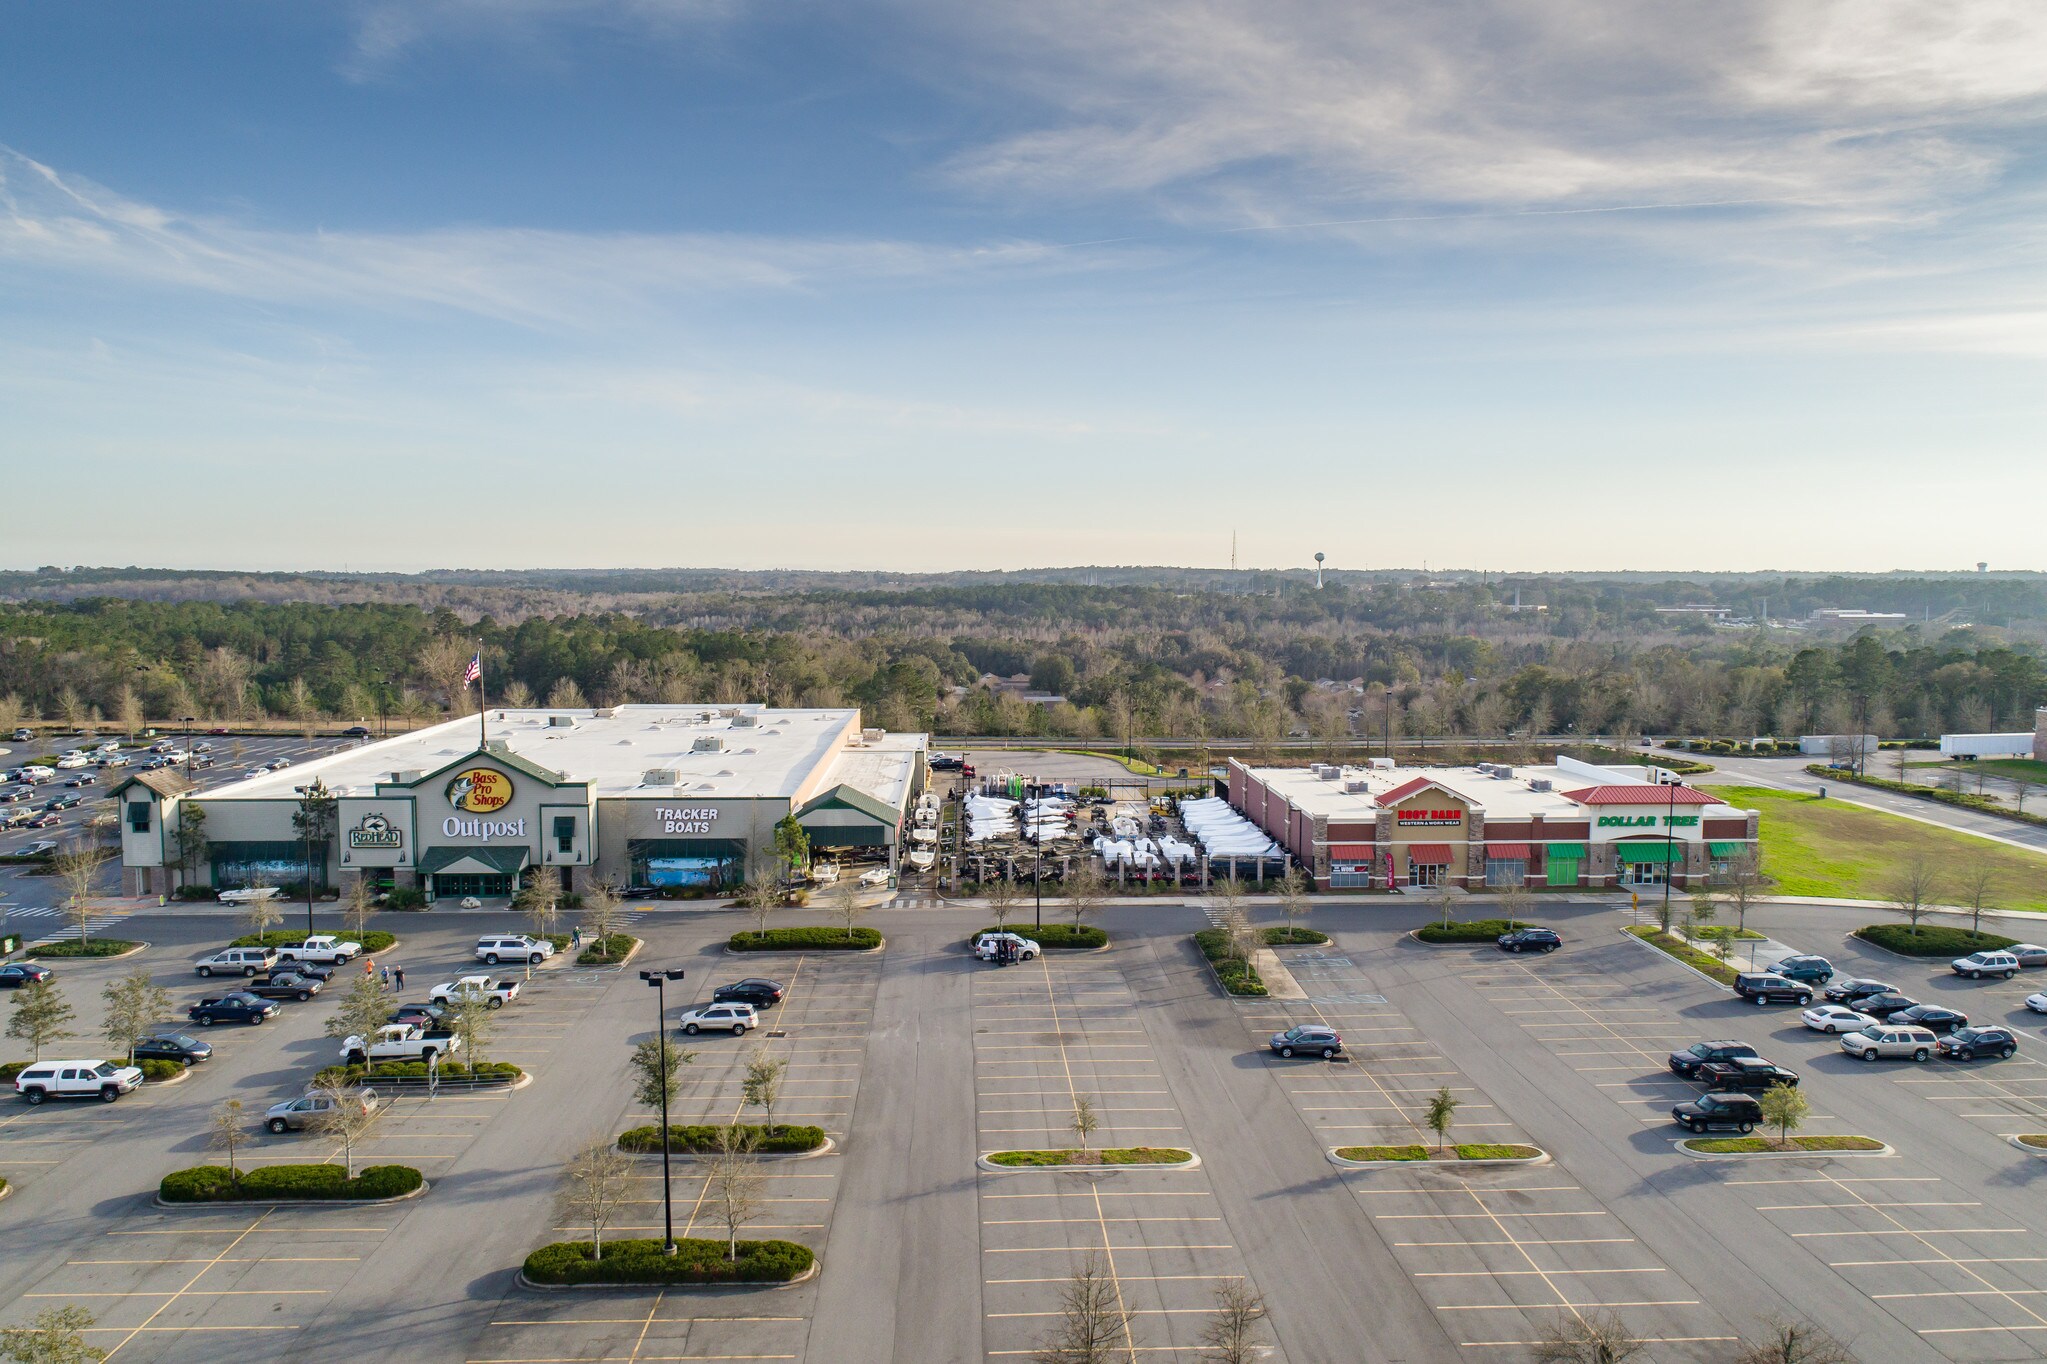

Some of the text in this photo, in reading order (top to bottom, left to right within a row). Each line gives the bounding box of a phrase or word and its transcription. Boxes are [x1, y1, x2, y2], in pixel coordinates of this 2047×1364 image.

[471, 772, 497, 784] Bass
[473, 784, 492, 794] Pro
[473, 794, 504, 808] Shops
[655, 808, 718, 820] TRACKER
[1398, 810, 1461, 819] BOOT BARN
[665, 821, 709, 833] BOATS
[1597, 816, 1699, 827] DOLLAR TREE
[442, 817, 526, 842] Outpost
